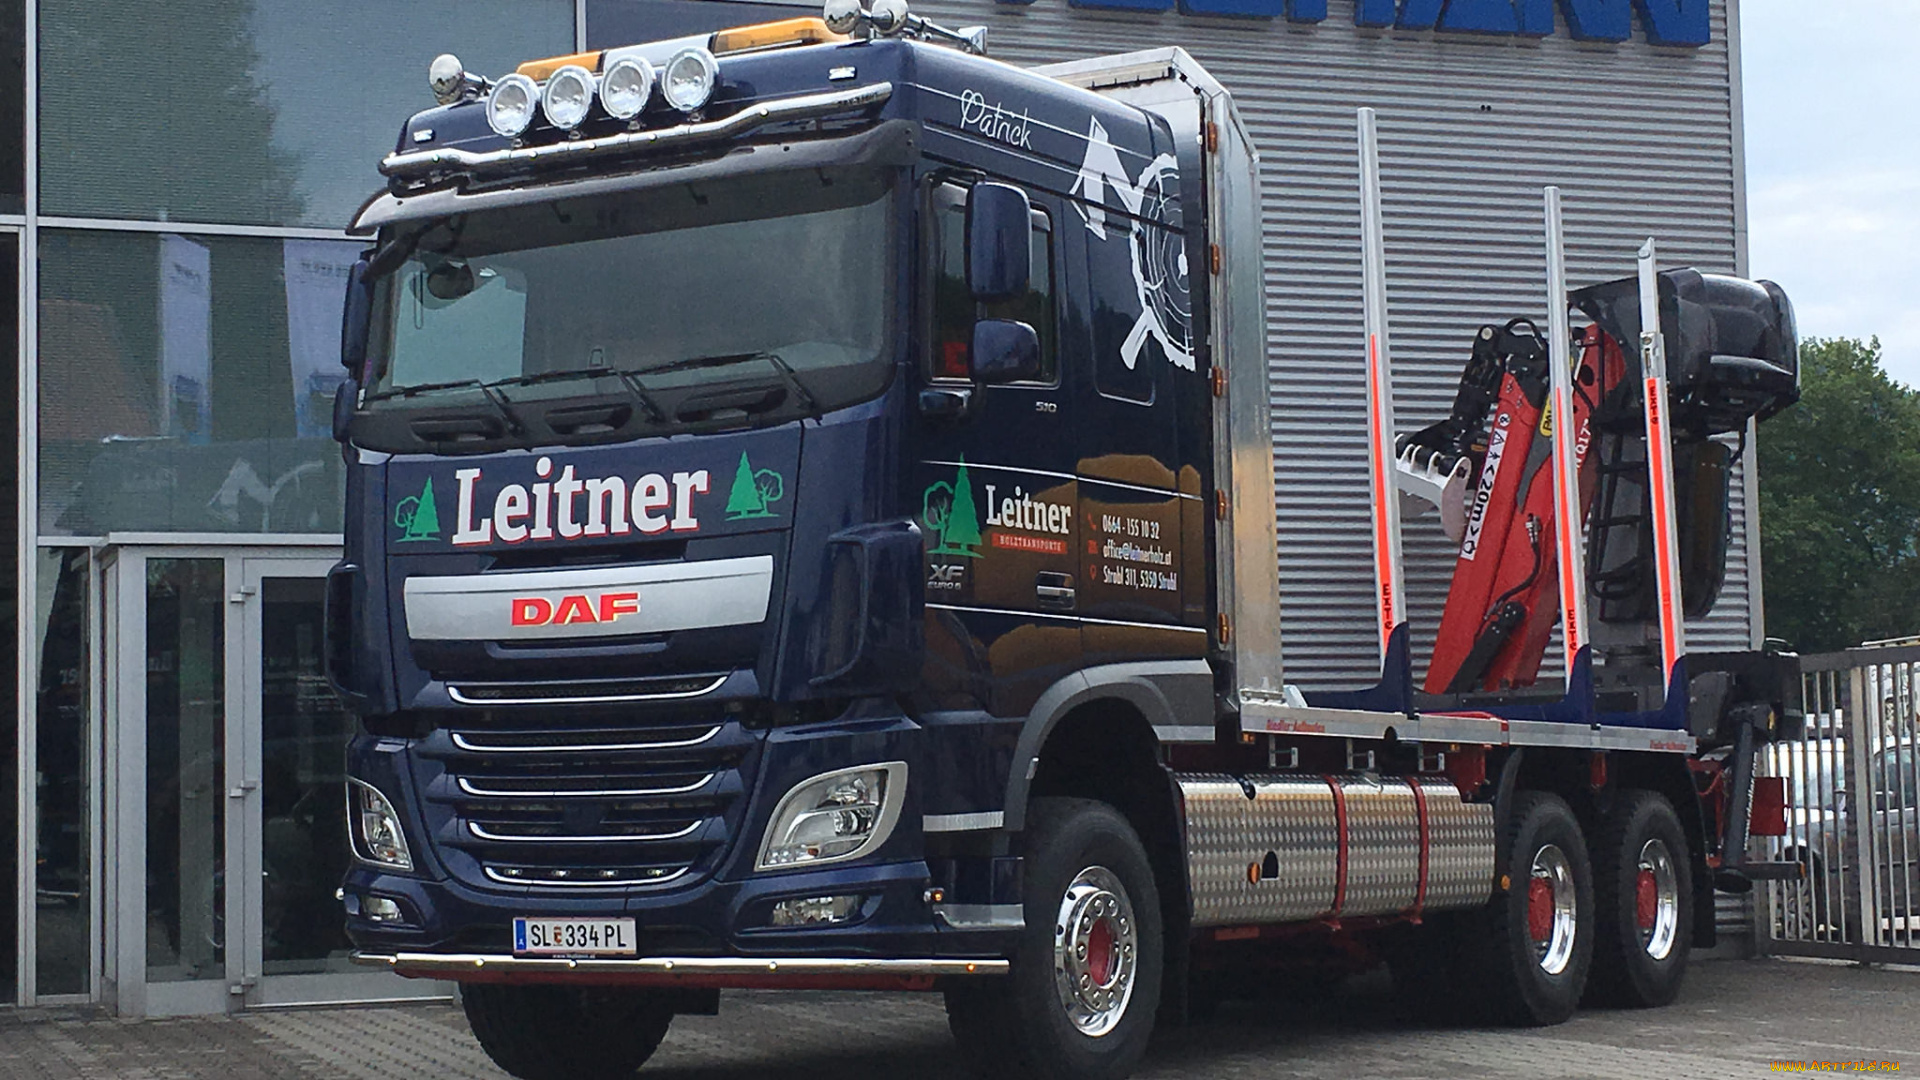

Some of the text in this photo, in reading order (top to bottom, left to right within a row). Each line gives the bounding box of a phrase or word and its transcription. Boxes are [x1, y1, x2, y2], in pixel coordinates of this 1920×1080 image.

[961, 89, 1032, 150] Patrick
[1035, 401, 1058, 413] 510
[452, 457, 711, 547] Leitner
[985, 484, 1072, 534] Leitner
[1102, 514, 1121, 534] 0664
[1126, 517, 1140, 537] 155
[1141, 520, 1150, 538] 10
[1150, 521, 1160, 540] 32
[999, 535, 1062, 552] HOLZTRANSPORTE
[929, 564, 965, 581] XF
[927, 581, 953, 590] EURO
[511, 592, 641, 626] DAF
[531, 924, 552, 947] SL
[565, 924, 600, 948] 334
[604, 924, 627, 948] PL
